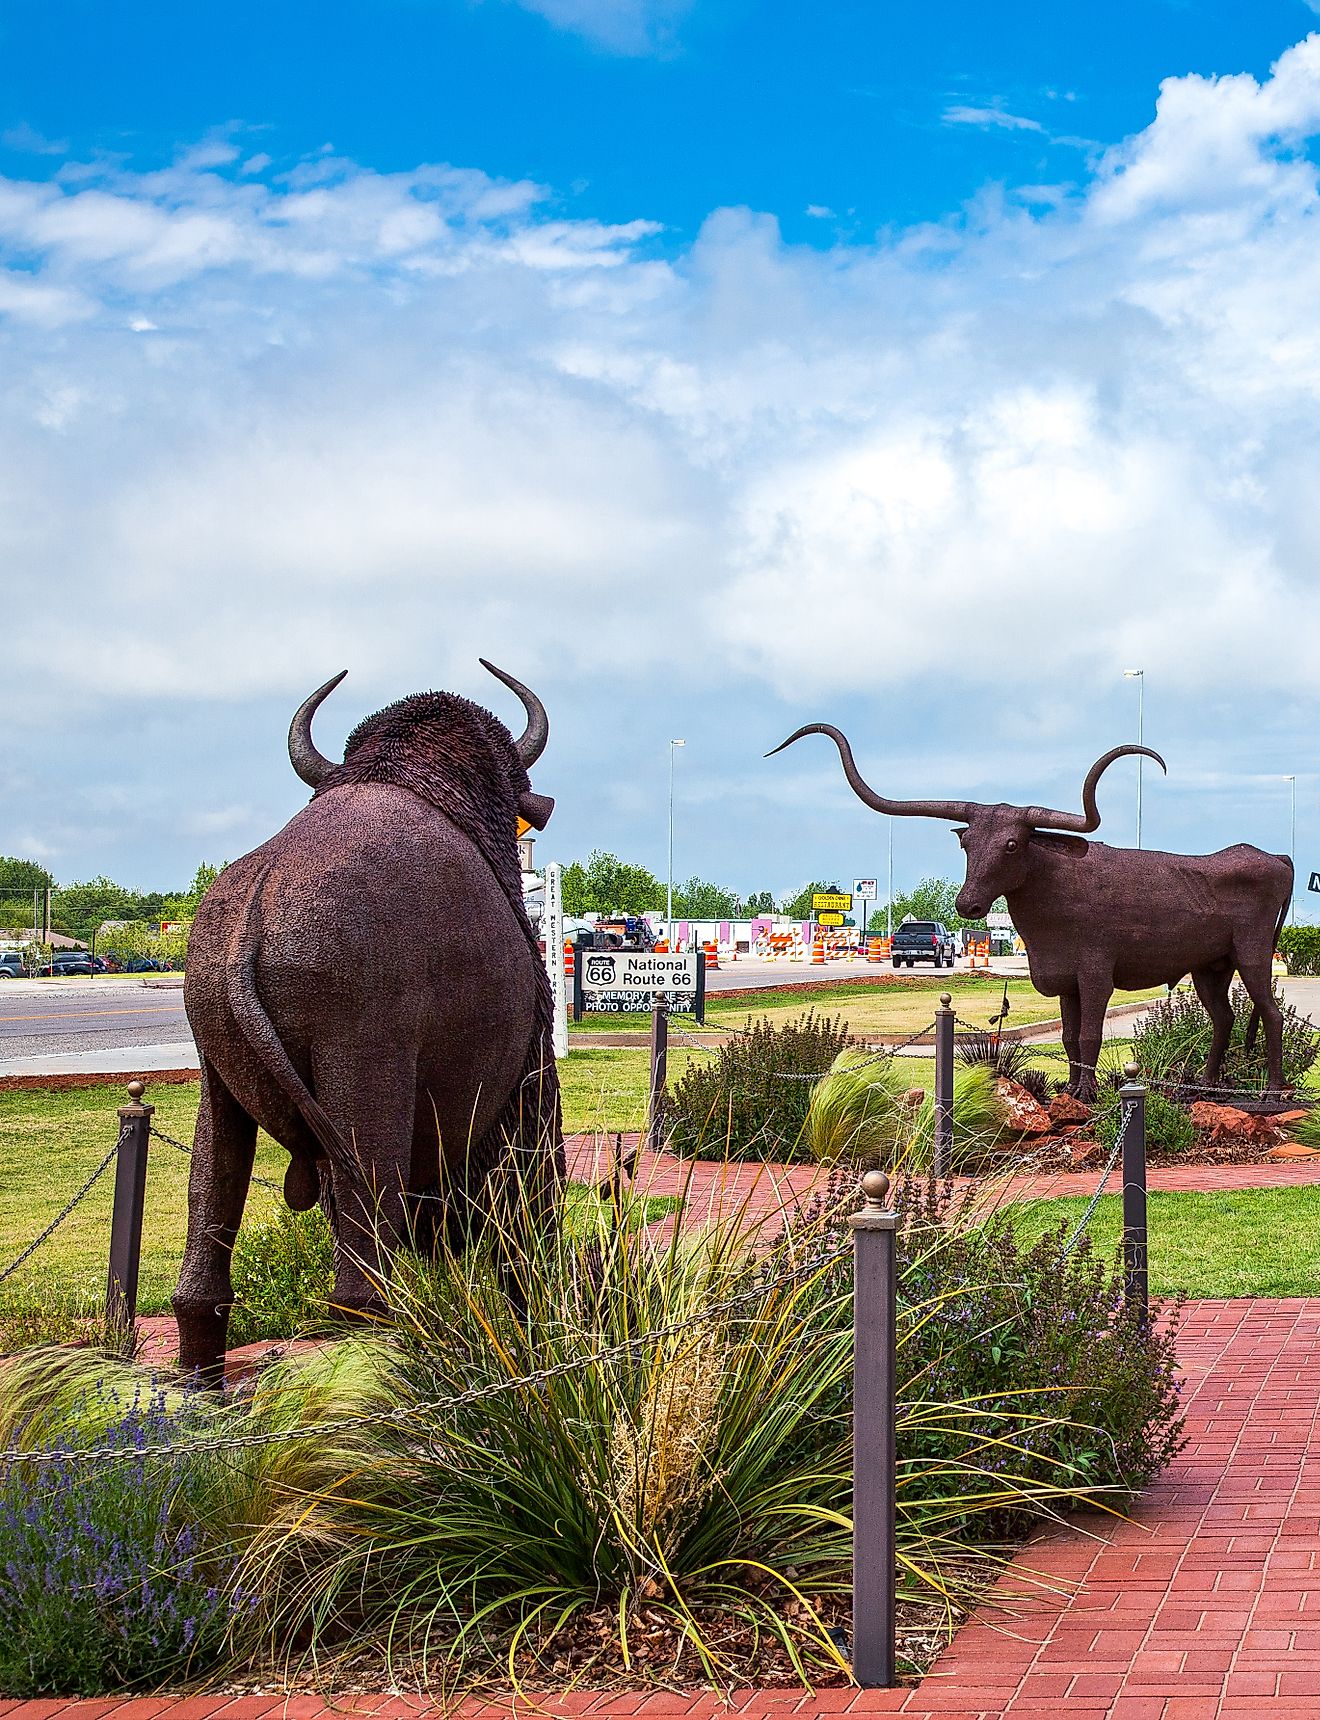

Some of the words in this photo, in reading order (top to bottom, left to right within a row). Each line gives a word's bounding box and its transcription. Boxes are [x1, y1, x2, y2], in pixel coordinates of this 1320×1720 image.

[628, 958, 687, 971] National
[590, 967, 612, 982] 66
[623, 973, 665, 985] Route
[671, 973, 692, 985] 66
[602, 991, 646, 1000] MEMORY
[650, 991, 677, 1000] LNE
[585, 1002, 619, 1011] PHOTO
[622, 1002, 692, 1012] OPPONITY
